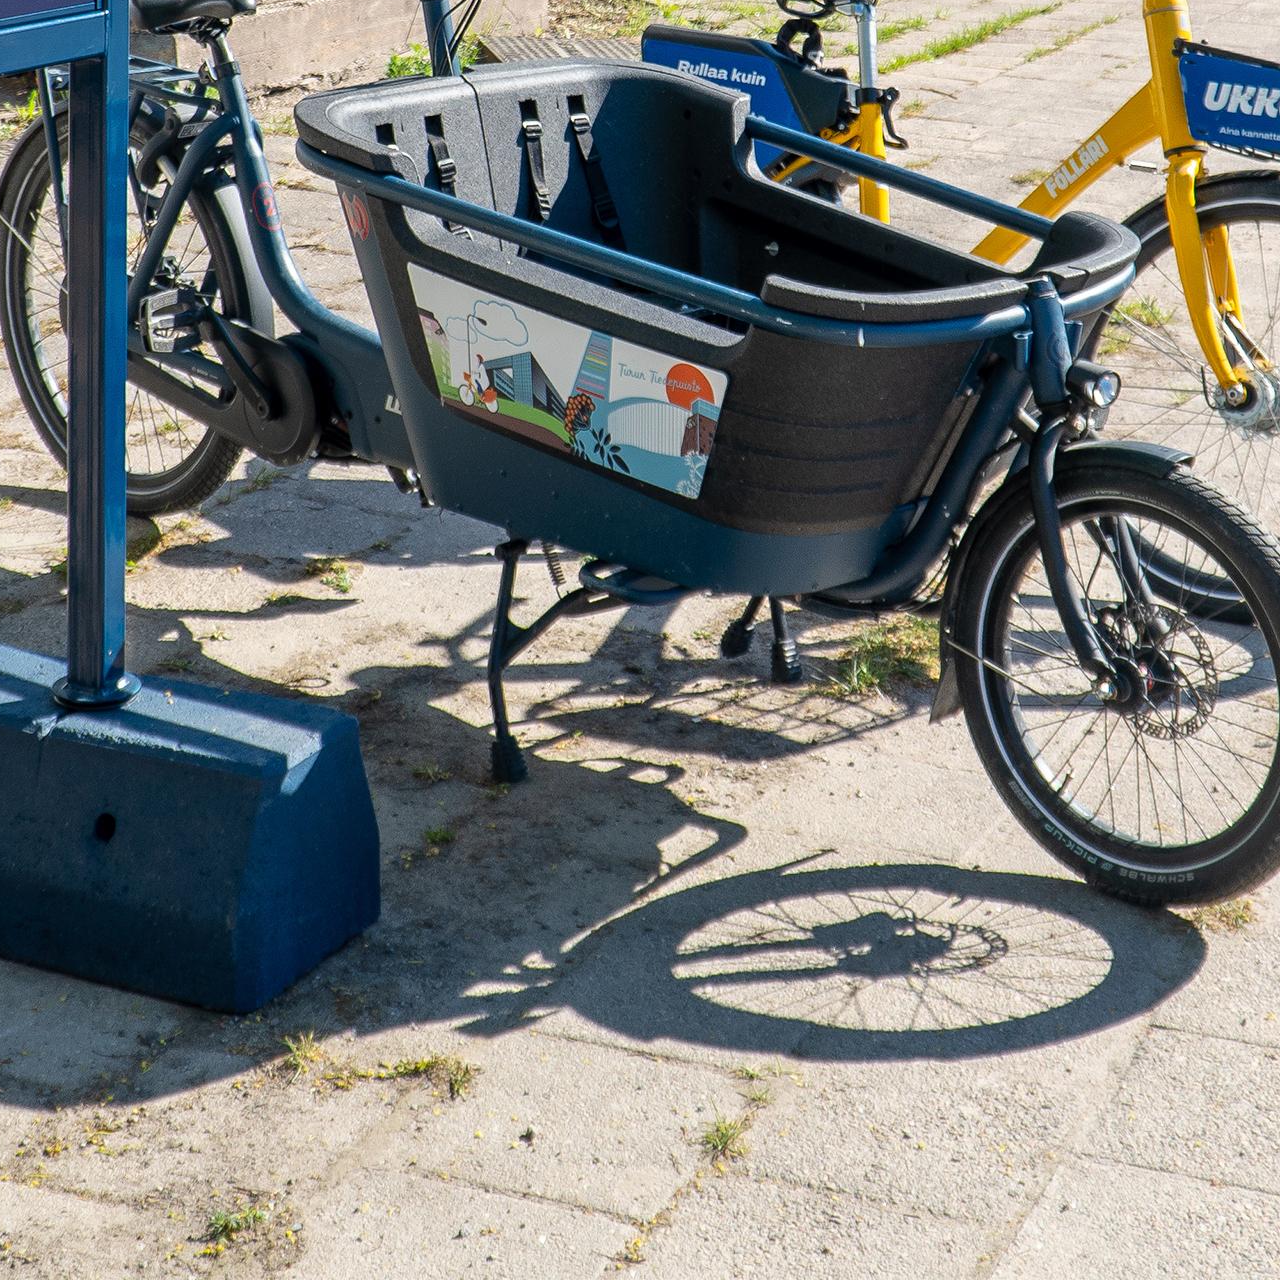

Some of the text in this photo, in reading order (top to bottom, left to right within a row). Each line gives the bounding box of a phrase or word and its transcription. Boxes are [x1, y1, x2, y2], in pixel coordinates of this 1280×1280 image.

[677, 59, 767, 87] Rullaa kuin
[1219, 125, 1241, 137] Aina
[1044, 133, 1110, 199] FÖLLÄRI
[618, 362, 701, 393] Turun Tiedepuisto
[1044, 823, 1097, 865] PICK-UP
[1120, 869, 1195, 884] SCHWALBE
